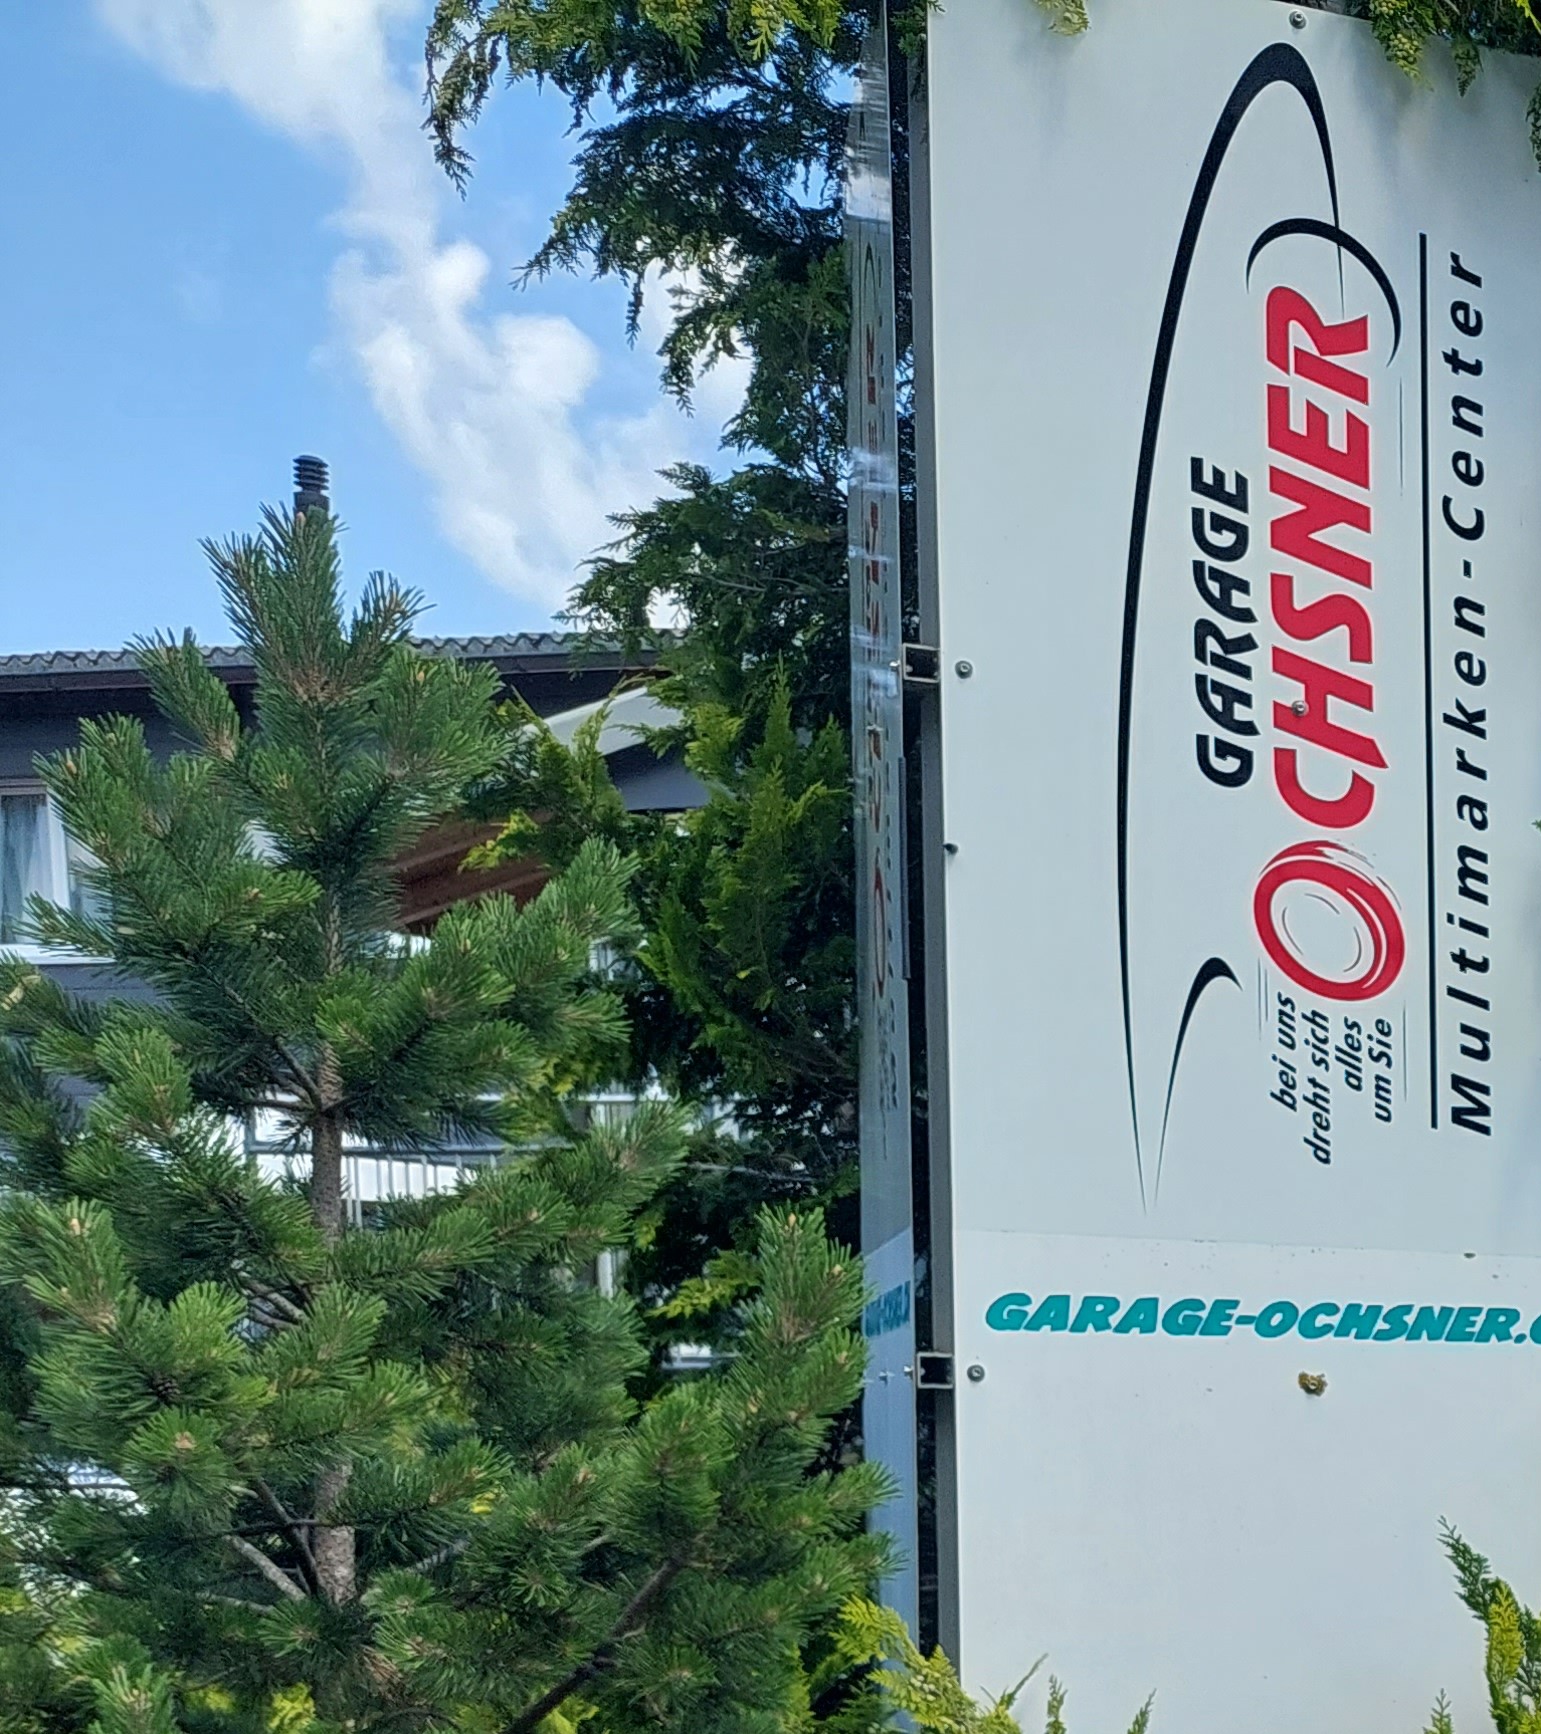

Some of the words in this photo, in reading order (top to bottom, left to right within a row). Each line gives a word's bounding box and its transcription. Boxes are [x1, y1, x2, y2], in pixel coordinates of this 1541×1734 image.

[1190, 455, 1256, 788] GARAGE
[1252, 285, 1406, 1002] OCHSNER
[1441, 251, 1494, 1137] Multimarken-Center
[1277, 991, 1297, 1051] uns
[1301, 1009, 1330, 1072] sich
[1335, 1016, 1363, 1092] alles
[1367, 1018, 1393, 1069] Sie
[1270, 1054, 1297, 1112] bei
[1373, 1074, 1393, 1123] um
[1303, 1077, 1332, 1165] dreht
